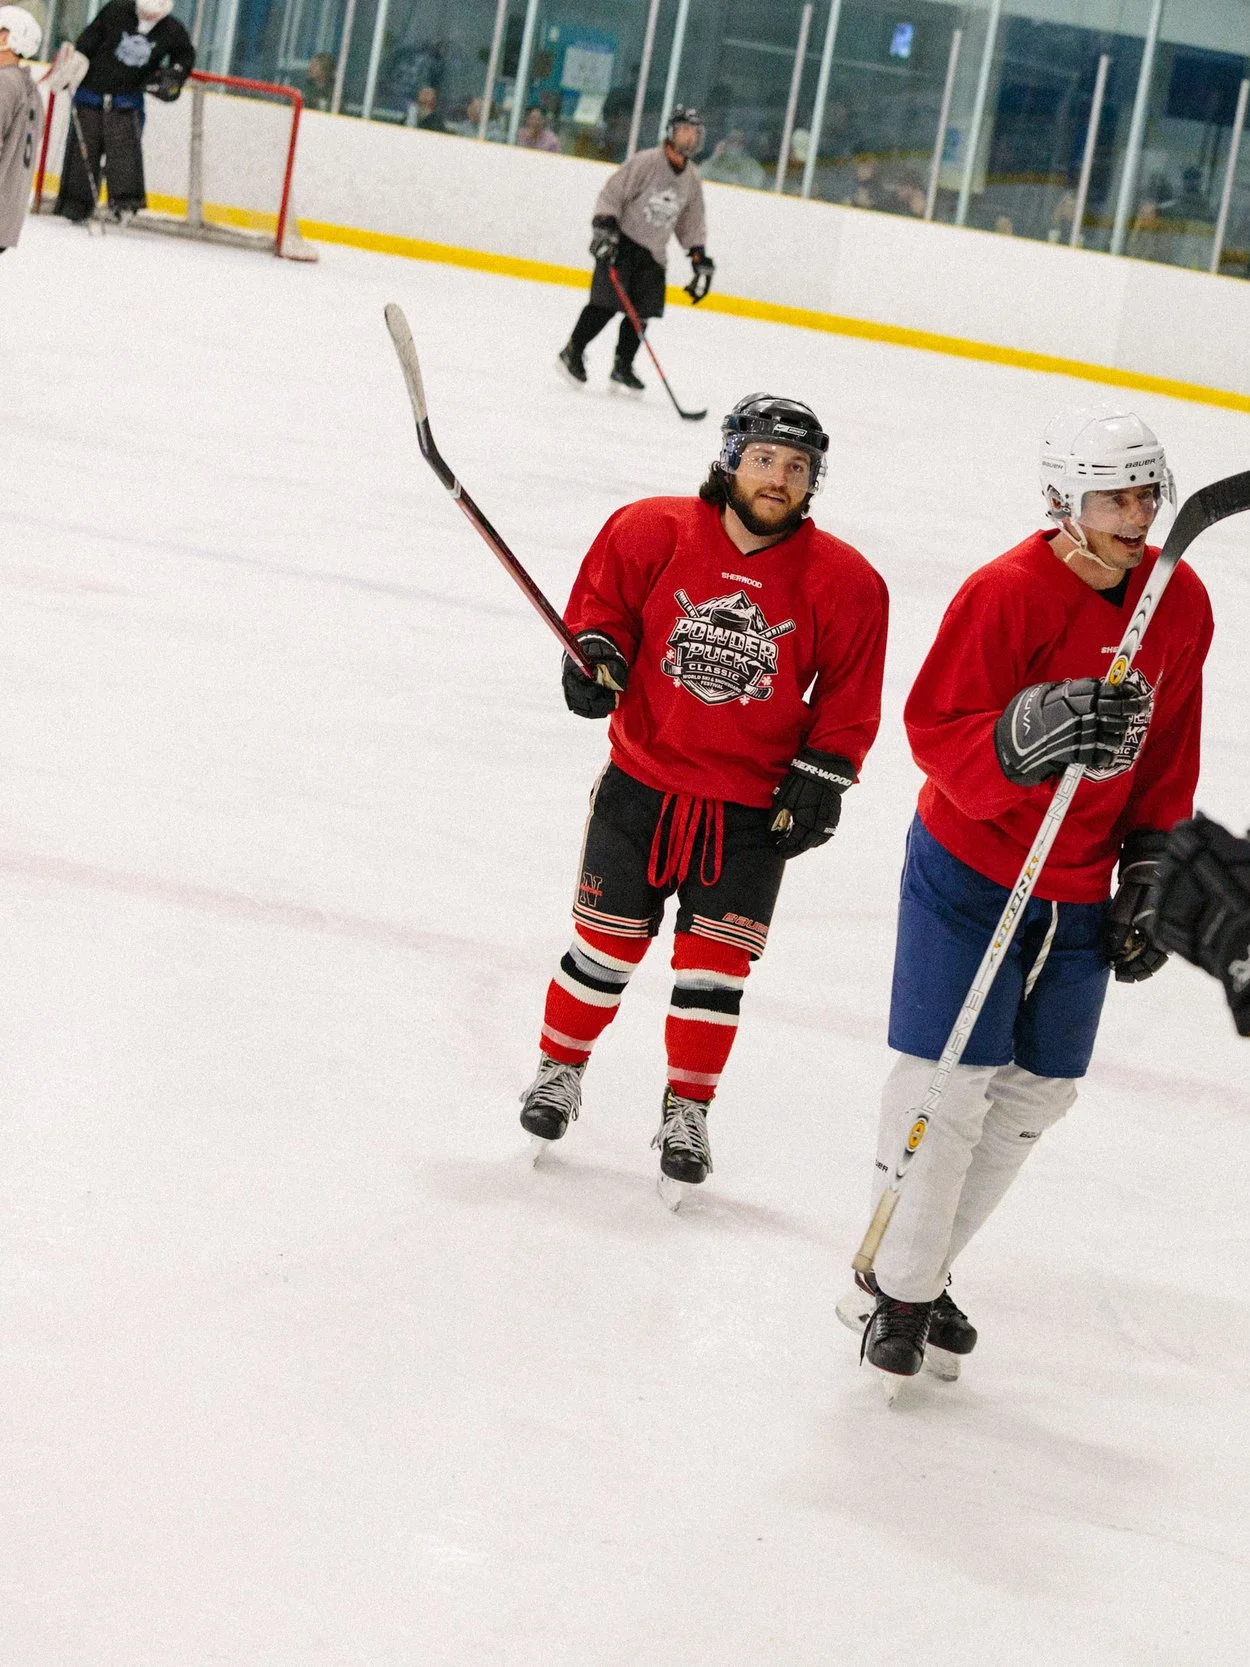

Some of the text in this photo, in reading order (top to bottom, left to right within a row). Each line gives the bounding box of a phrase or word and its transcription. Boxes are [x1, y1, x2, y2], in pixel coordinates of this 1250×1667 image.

[1125, 458, 1156, 469] BAUER
[721, 572, 763, 589] SHERWOOD
[671, 619, 777, 671] POWDER
[685, 641, 750, 676] PUCK
[688, 663, 740, 681] CLASSIC
[700, 680, 724, 690] FESTIVAL
[791, 758, 852, 787] HER-WOOD
[921, 988, 985, 1114] EASTON
